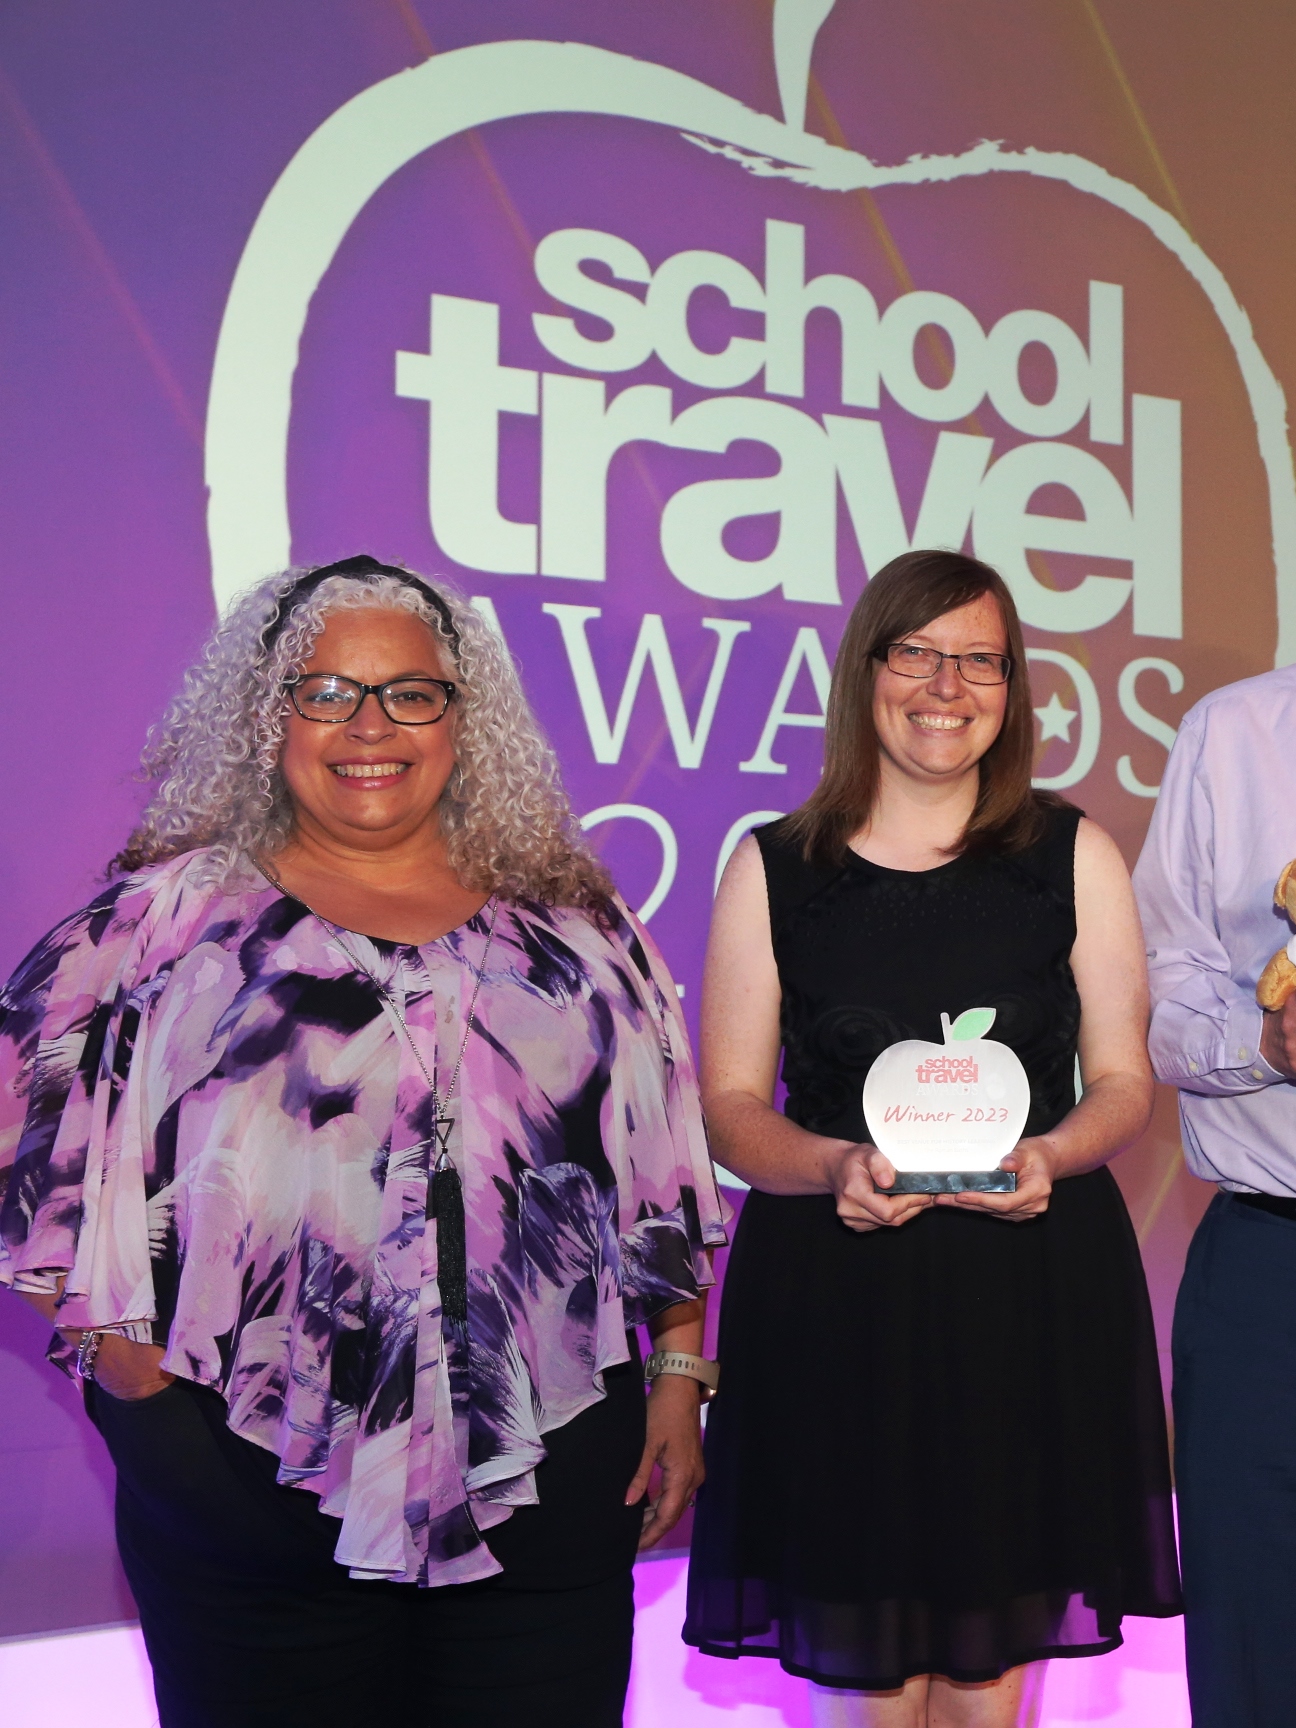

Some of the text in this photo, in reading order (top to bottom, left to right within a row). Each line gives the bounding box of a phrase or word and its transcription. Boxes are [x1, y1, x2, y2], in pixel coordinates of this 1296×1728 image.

[532, 218, 1123, 446] school
[395, 293, 1183, 640] travel
[925, 1056, 973, 1069] school
[915, 1064, 979, 1083] travel
[915, 1084, 979, 1096] AWARDS
[884, 1104, 1009, 1123] Winner 2023
